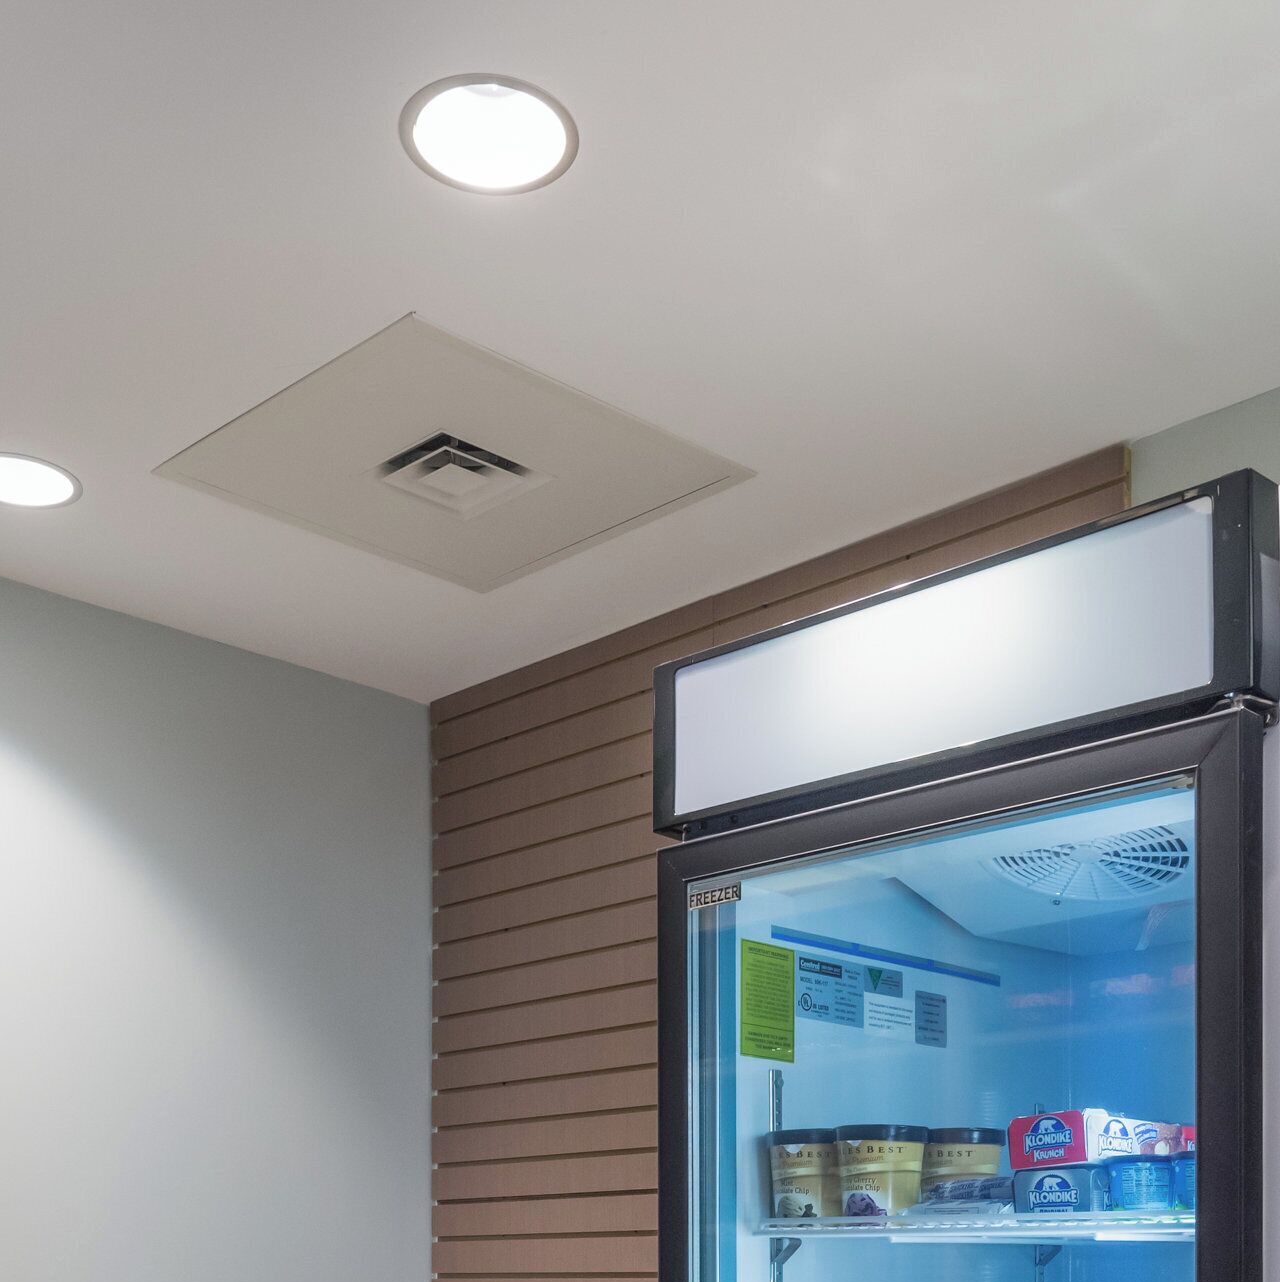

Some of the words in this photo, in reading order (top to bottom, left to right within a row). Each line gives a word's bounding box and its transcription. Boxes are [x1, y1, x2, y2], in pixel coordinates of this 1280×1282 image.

[690, 885, 739, 908] FREEZER
[1025, 1130, 1072, 1155] KLONDIKE
[867, 1146, 903, 1154] BEST
[1034, 1148, 1064, 1162] KRUNCH
[796, 1187, 809, 1195] Chip
[864, 1184, 880, 1192] Chip
[1029, 1189, 1077, 1209] KLONDIKE
